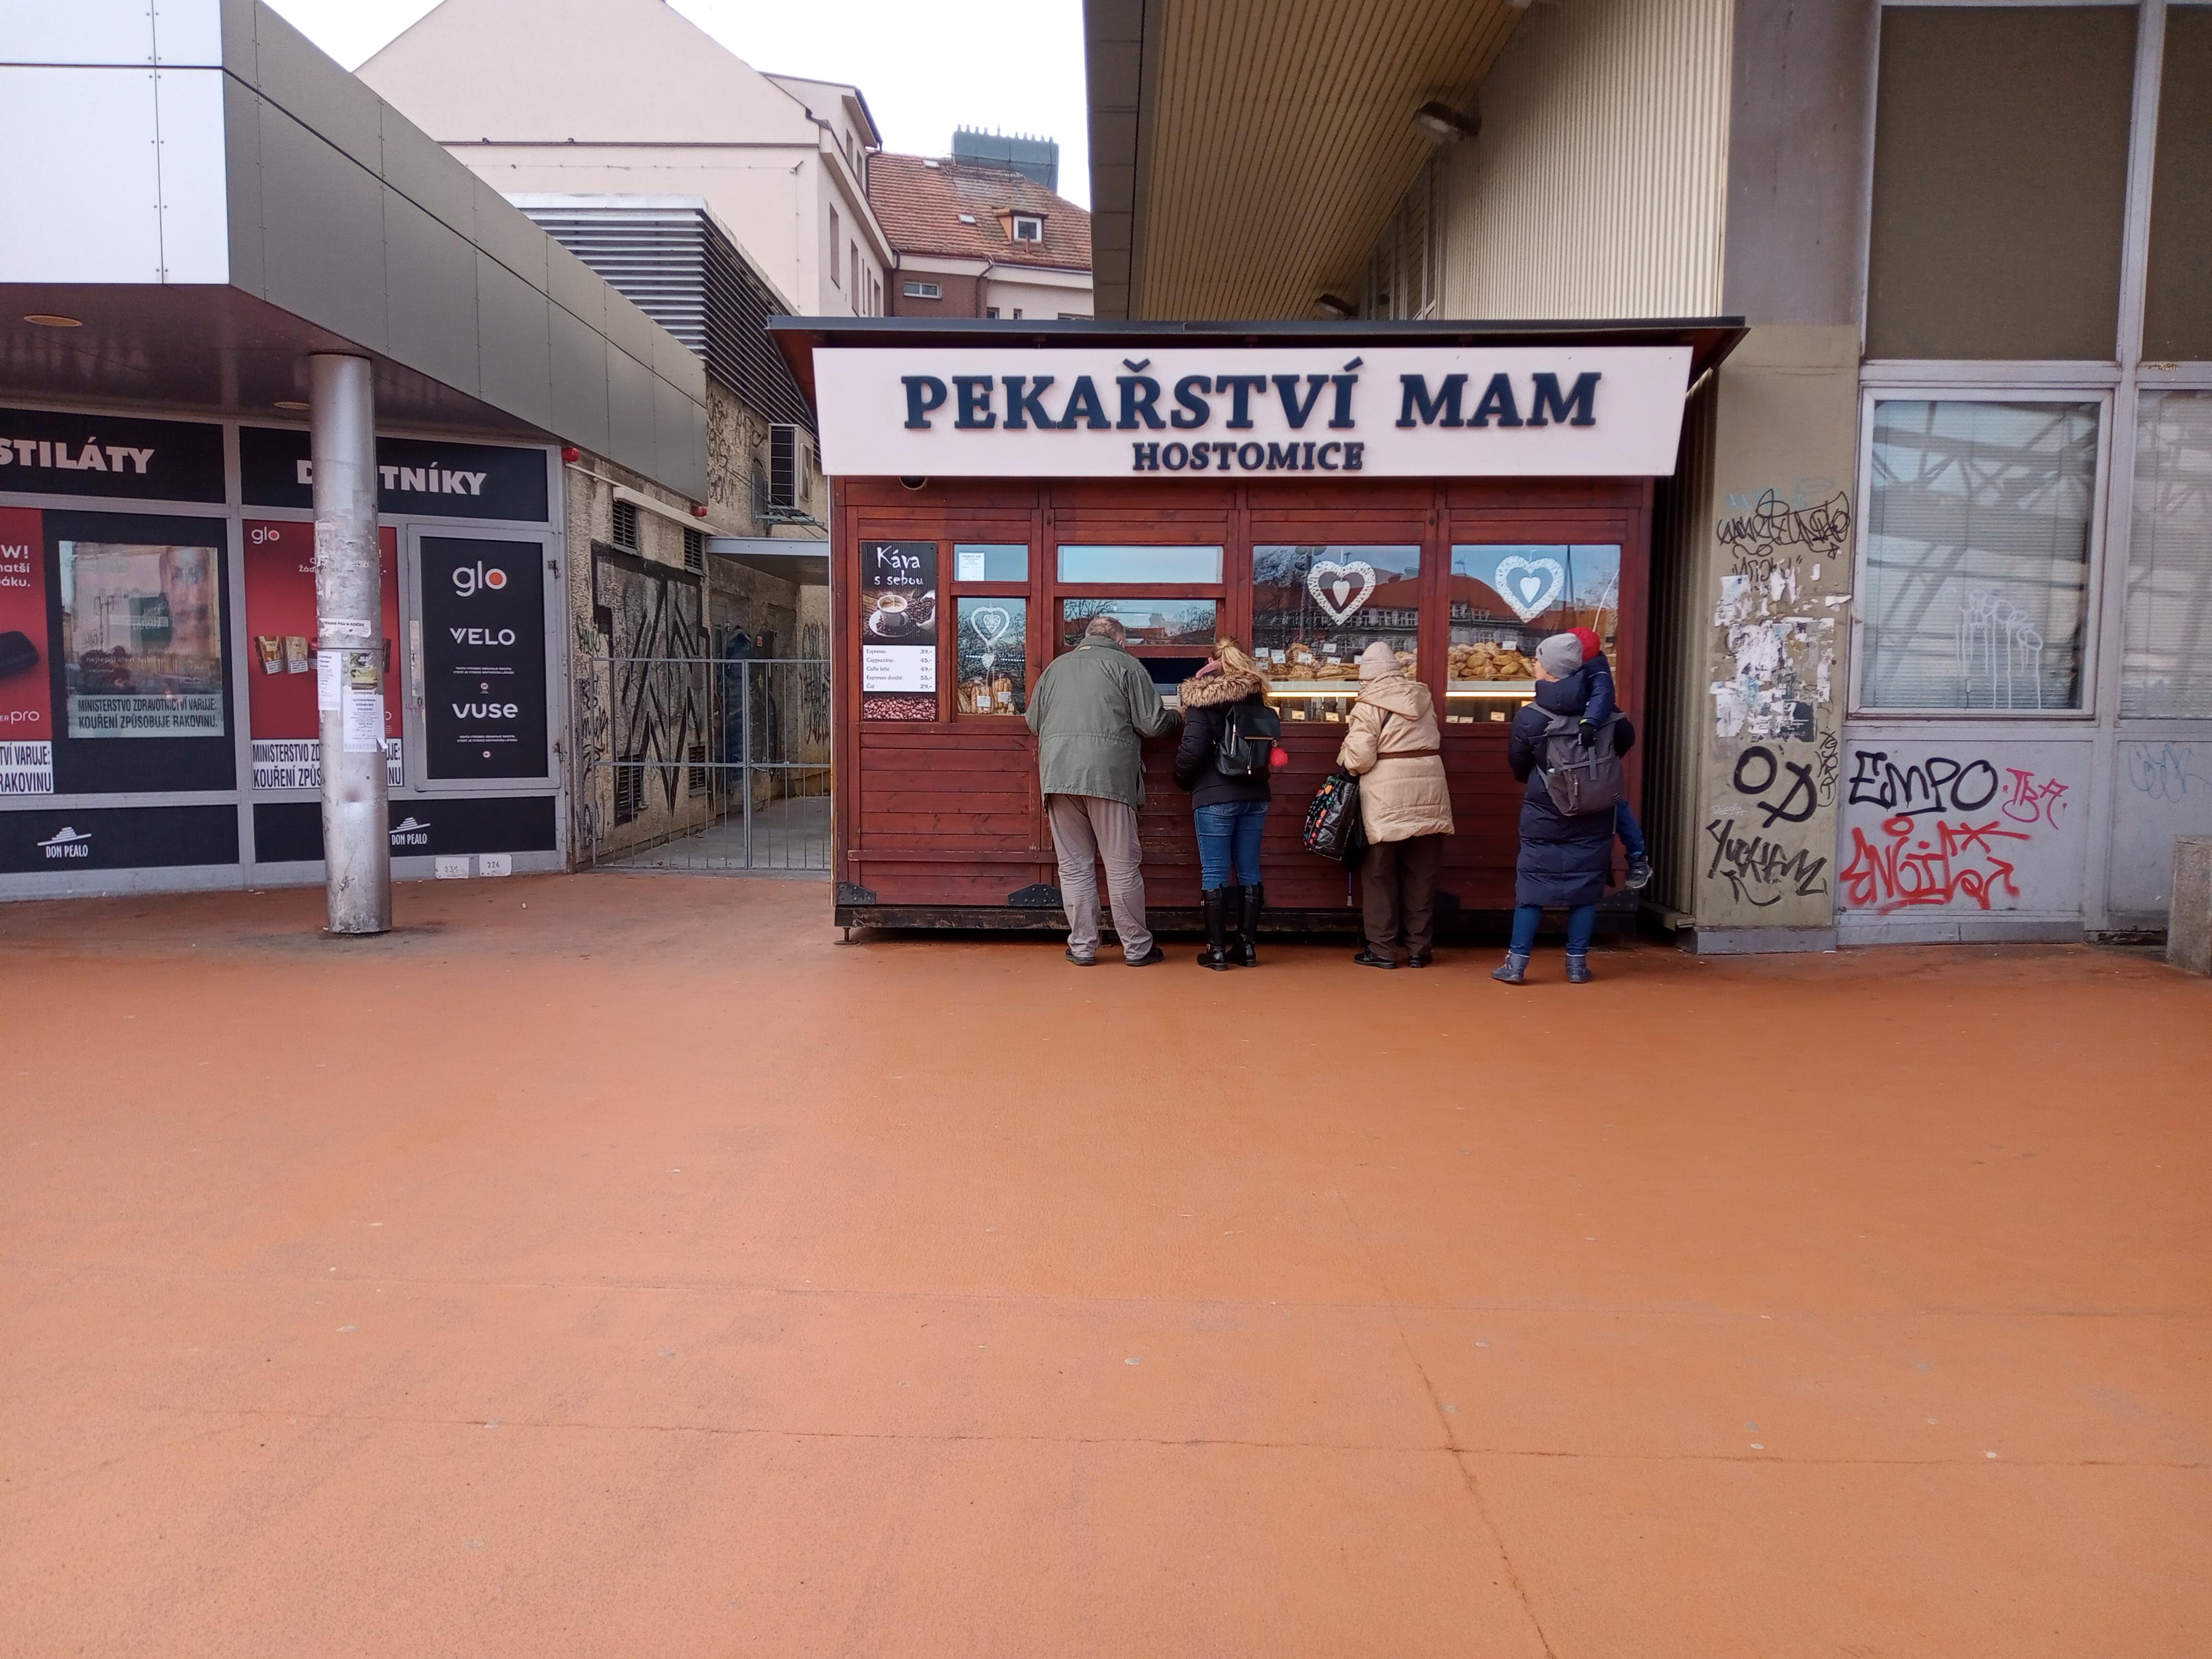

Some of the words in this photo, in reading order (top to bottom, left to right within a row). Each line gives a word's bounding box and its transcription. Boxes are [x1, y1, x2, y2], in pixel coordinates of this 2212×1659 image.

[901, 356, 1364, 430] PEKAŘSTVÍ
[1395, 372, 1602, 428] MAM
[1132, 441, 1365, 472] HOSTOMICE
[296, 460, 487, 495] DTNÍKY
[251, 526, 280, 545] glo
[877, 545, 920, 568] Káva
[452, 560, 507, 597] glo
[874, 576, 880, 585] s
[886, 570, 924, 586] sebou
[449, 628, 516, 646] VELO
[78, 698, 131, 712] MINISTERSTVO
[189, 698, 217, 710] VARUJE:
[11, 711, 40, 725] pro
[79, 713, 118, 729] KOUŘENÍ
[120, 713, 171, 729] ZPŮSOBUJE
[14, 746, 51, 765] VARUJE:
[252, 743, 309, 763] MINISTERSTVO
[253, 764, 295, 787] KOUŘENÍ
[1849, 750, 1999, 816] EMPO
[392, 834, 405, 845] DON
[407, 833, 427, 845] PEALO
[46, 846, 62, 858] DON
[64, 844, 88, 858] PEALO
